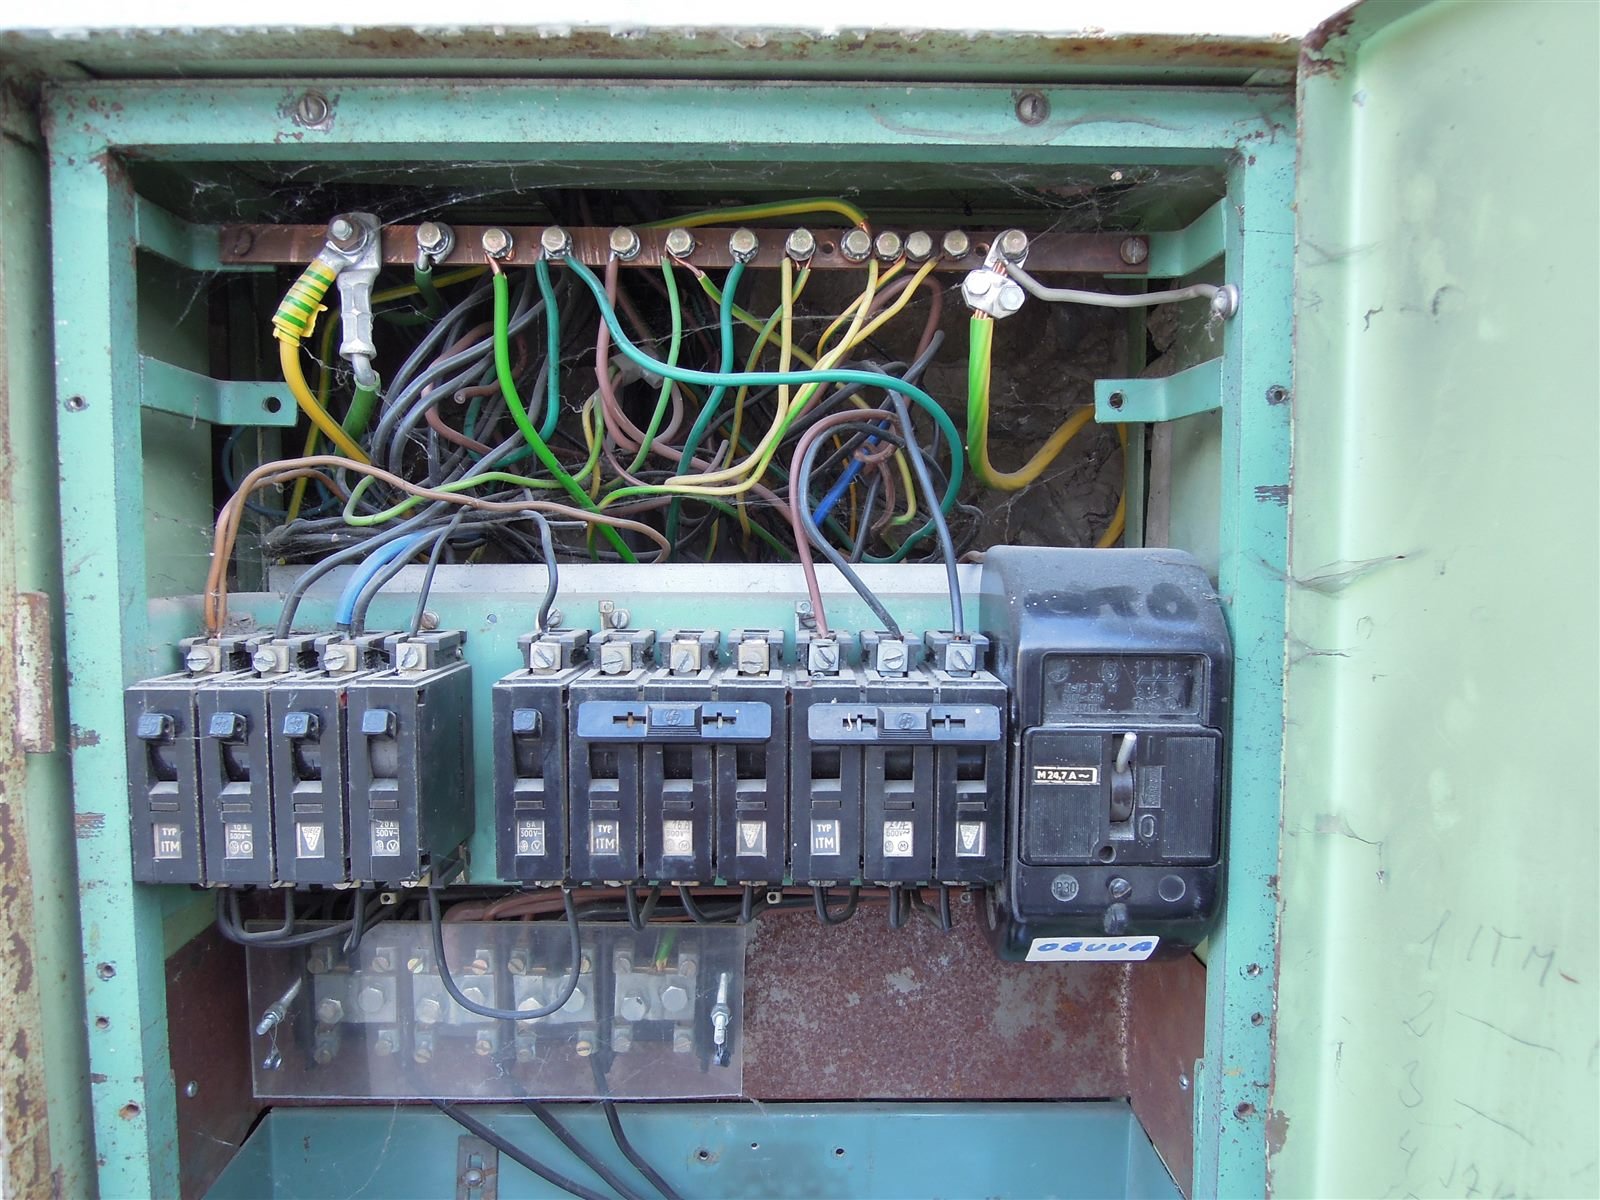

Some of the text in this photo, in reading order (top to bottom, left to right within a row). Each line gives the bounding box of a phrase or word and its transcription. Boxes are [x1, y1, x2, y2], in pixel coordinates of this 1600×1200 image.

[1037, 771, 1046, 779] M
[162, 827, 177, 836] TYP
[597, 825, 613, 833] TYP
[817, 824, 832, 833] TYP
[161, 840, 180, 852] ITM
[595, 838, 615, 849] ITM
[815, 837, 834, 849] ITM
[1053, 881, 1077, 894] IP30
[1399, 1060, 1424, 1108] 3
